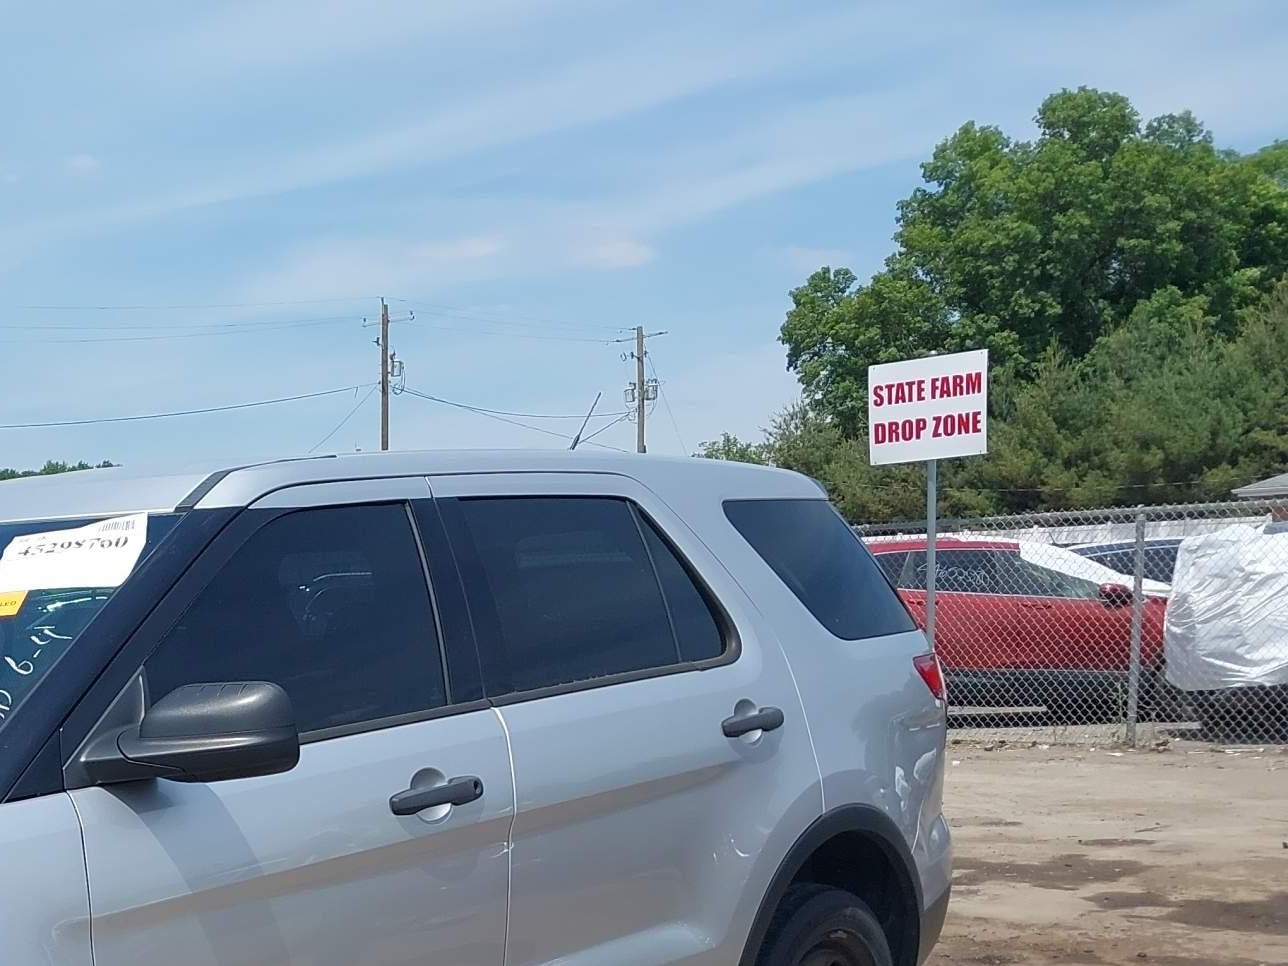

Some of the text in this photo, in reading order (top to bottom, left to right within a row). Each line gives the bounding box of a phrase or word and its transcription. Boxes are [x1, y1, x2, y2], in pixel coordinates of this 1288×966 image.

[873, 372, 982, 406] STATE FARM
[874, 412, 982, 445] DROP ZONE
